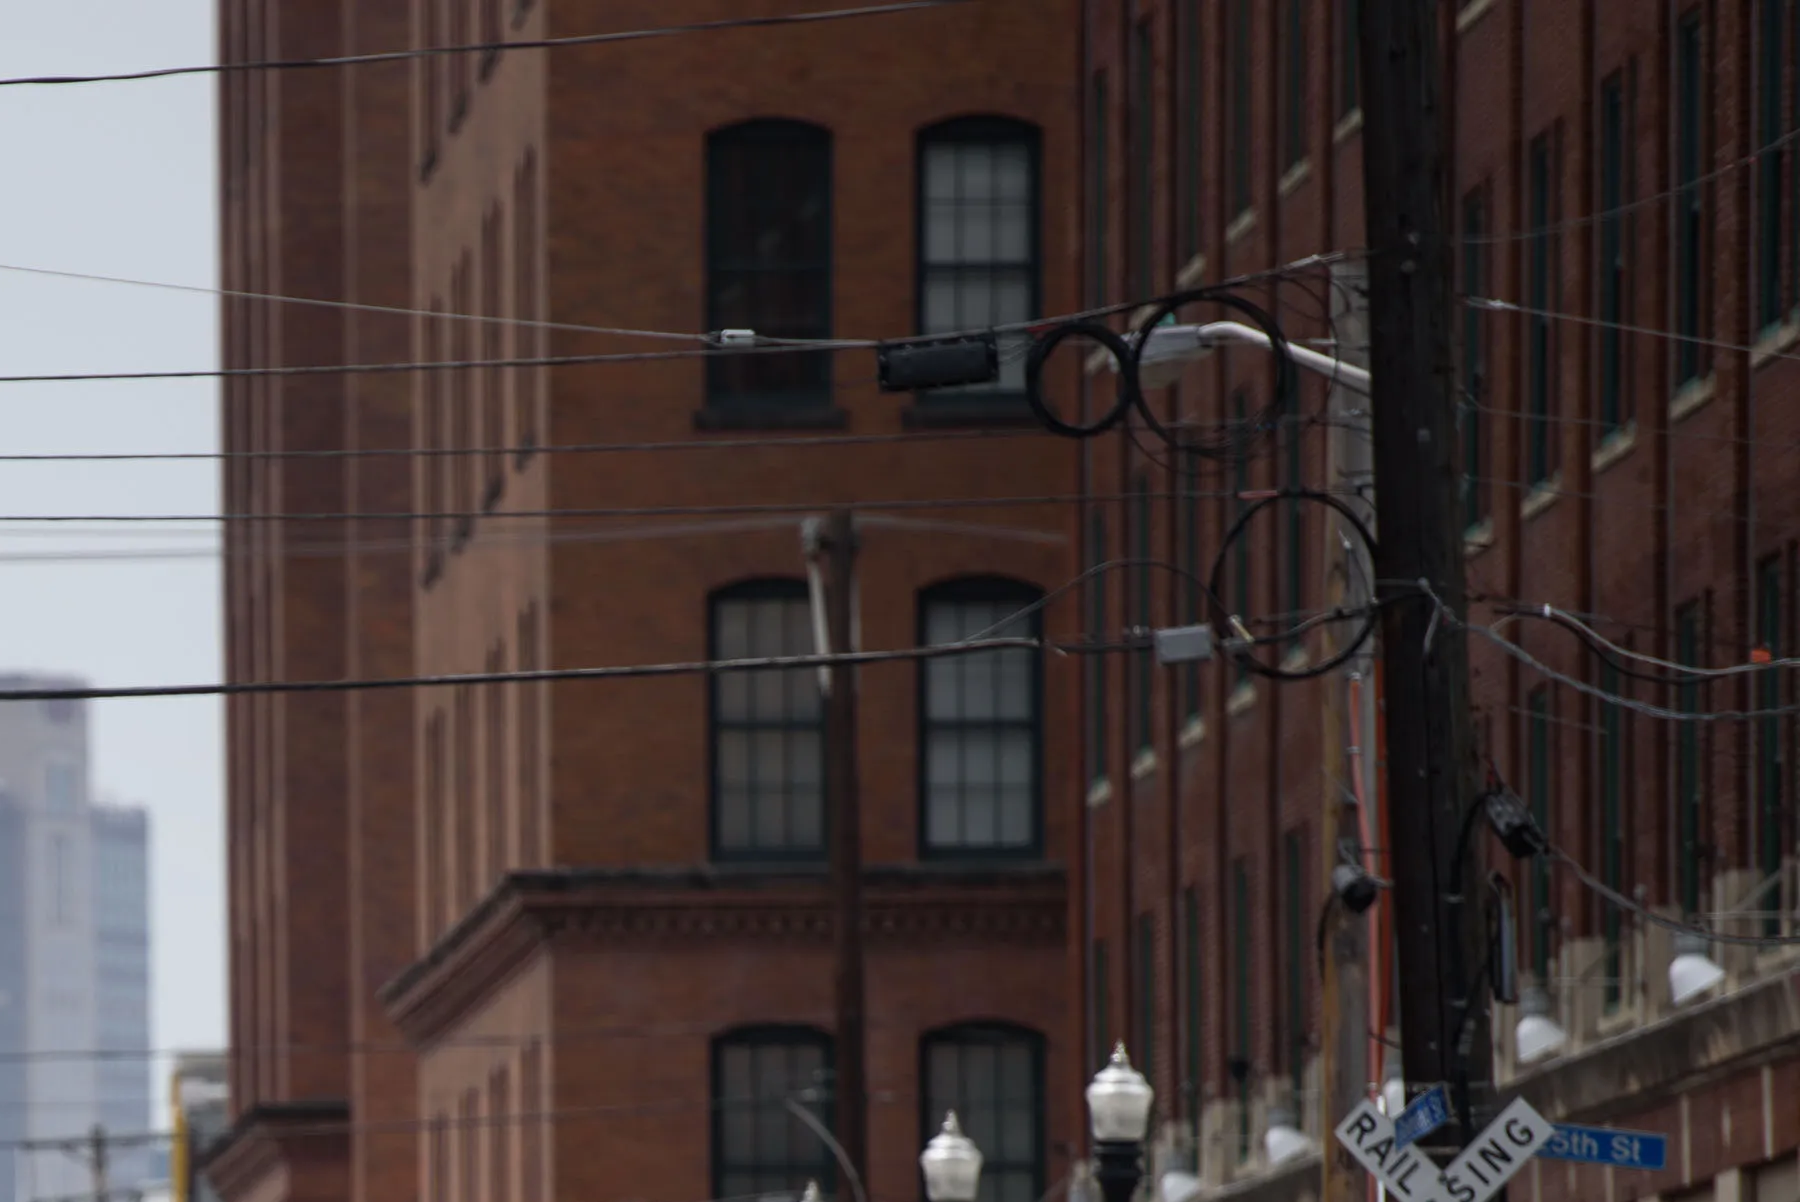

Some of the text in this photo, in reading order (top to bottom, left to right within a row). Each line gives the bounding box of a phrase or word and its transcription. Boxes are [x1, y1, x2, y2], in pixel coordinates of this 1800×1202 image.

[1346, 1111, 1421, 1197] RAIL
[1540, 1128, 1641, 1164] 5th St
